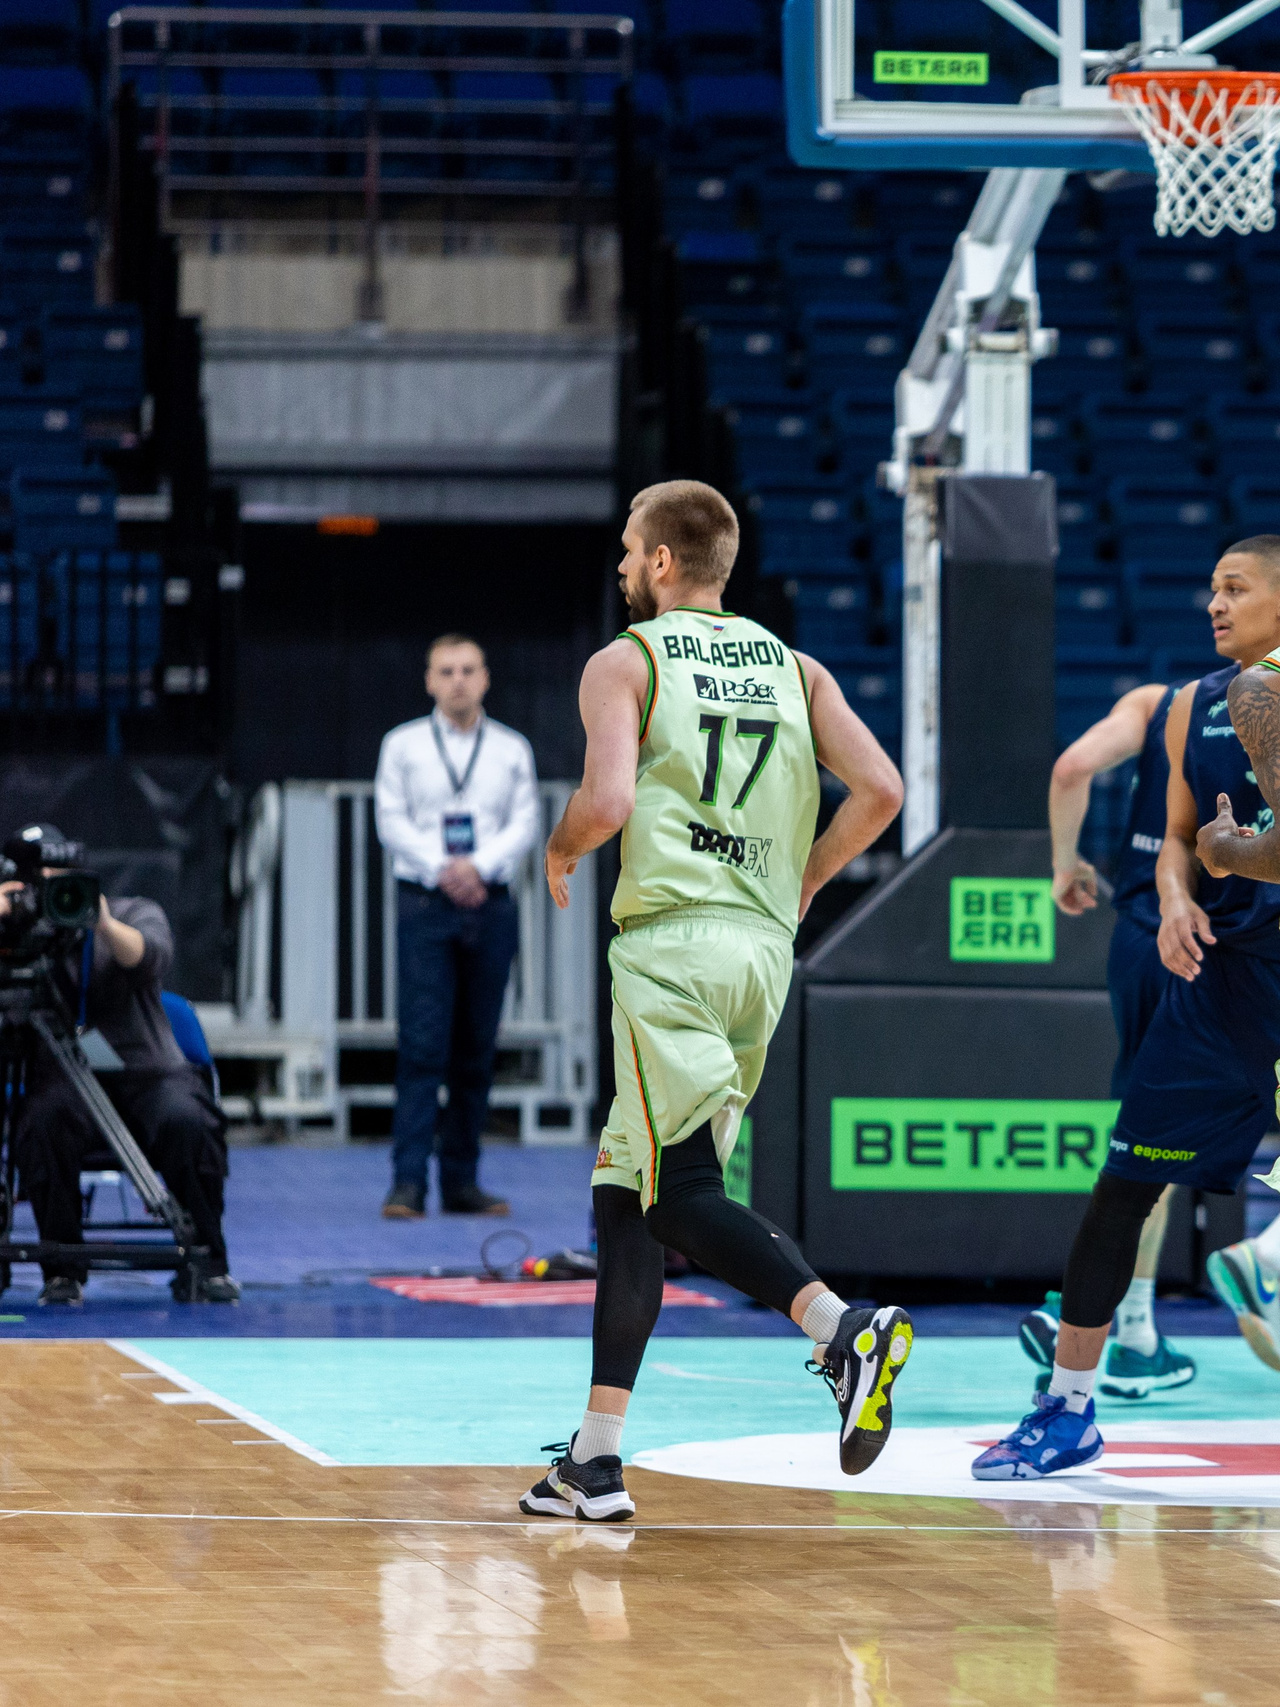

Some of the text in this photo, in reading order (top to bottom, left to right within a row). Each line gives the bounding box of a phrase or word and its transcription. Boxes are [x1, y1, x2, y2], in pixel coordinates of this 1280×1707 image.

[662, 634, 785, 668] BALASHOV
[698, 713, 780, 810] 17
[963, 891, 1041, 916] BET
[854, 1121, 1098, 1169] BET.ER
